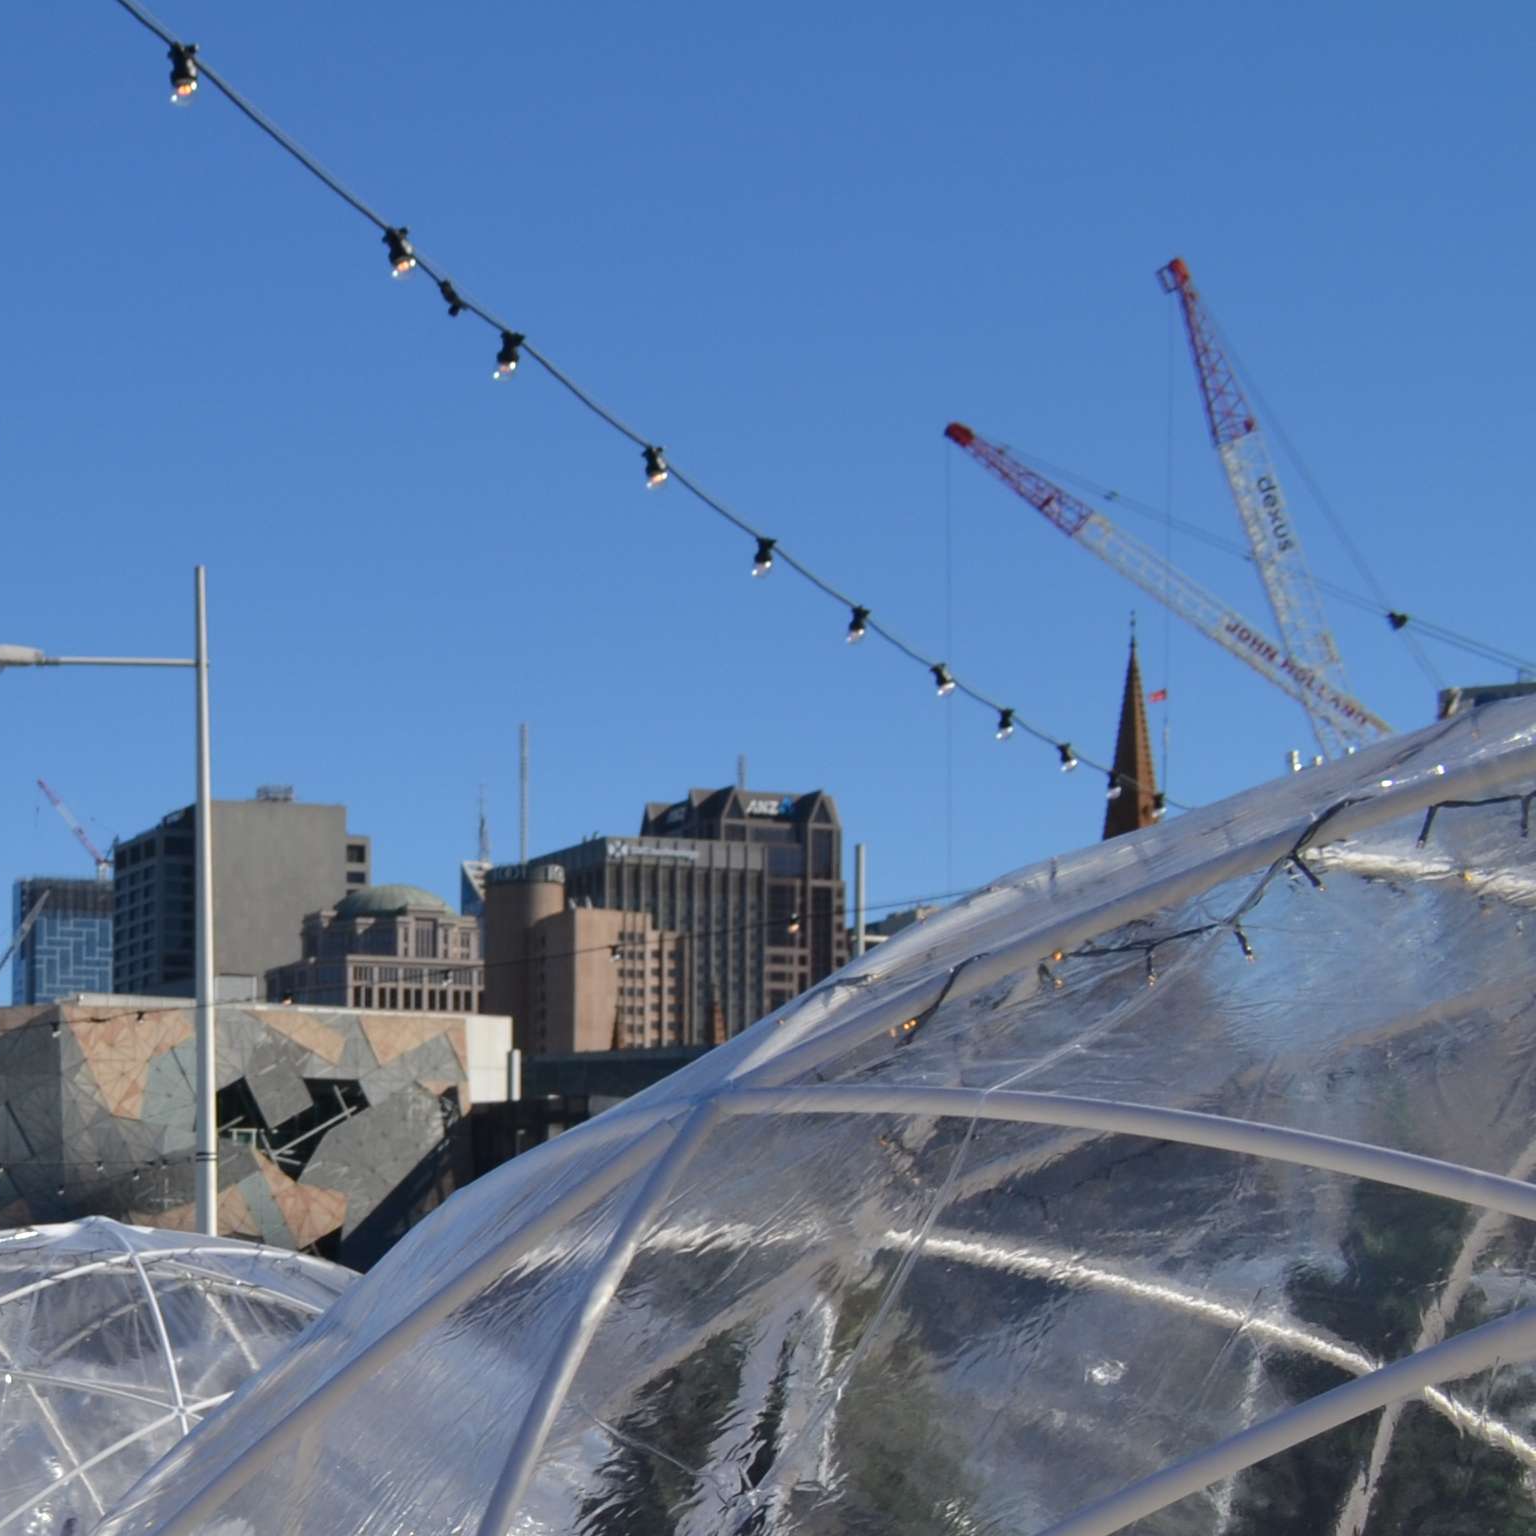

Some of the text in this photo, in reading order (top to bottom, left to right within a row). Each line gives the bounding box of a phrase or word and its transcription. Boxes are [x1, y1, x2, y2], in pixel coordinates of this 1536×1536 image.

[1257, 475, 1294, 552] dexus
[1225, 622, 1278, 662] JOHN
[746, 799, 778, 816] ANZ
